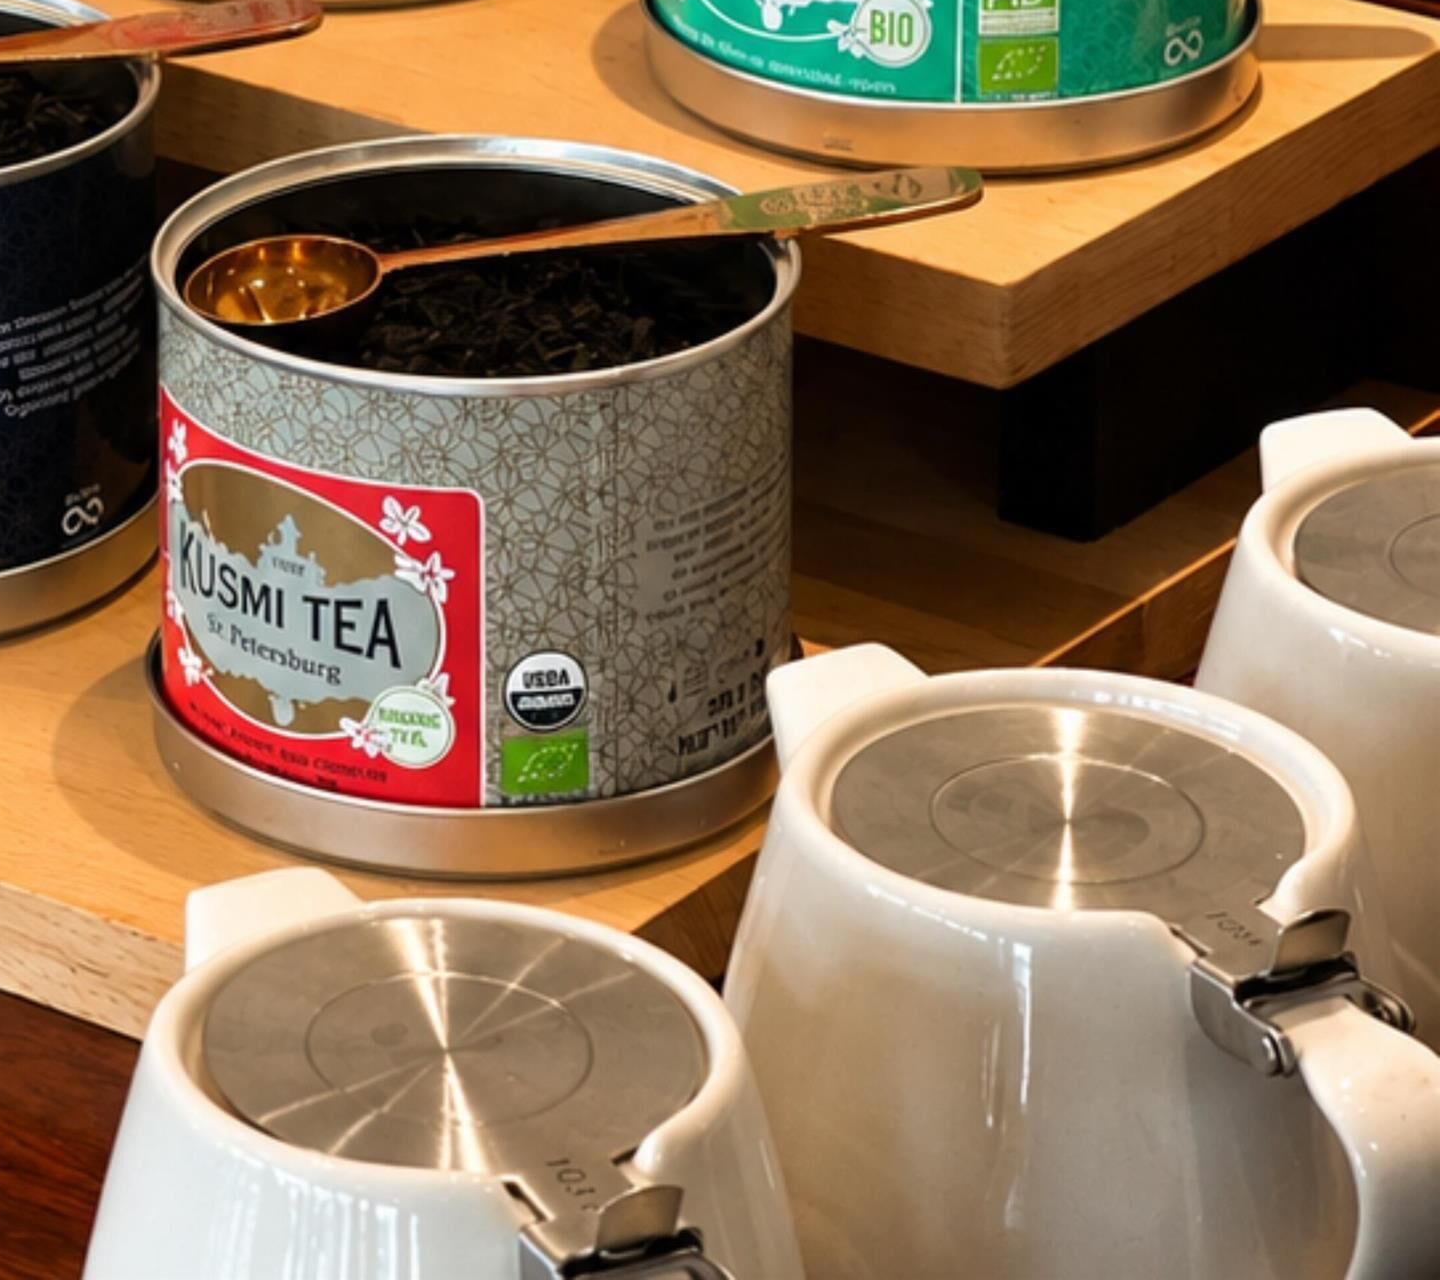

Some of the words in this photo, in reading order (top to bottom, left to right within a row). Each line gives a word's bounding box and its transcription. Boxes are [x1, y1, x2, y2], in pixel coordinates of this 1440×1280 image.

[869, 8, 915, 48] BIO
[179, 519, 285, 630] KUSMI
[301, 596, 403, 670] TEA
[230, 623, 342, 687] Petersburg
